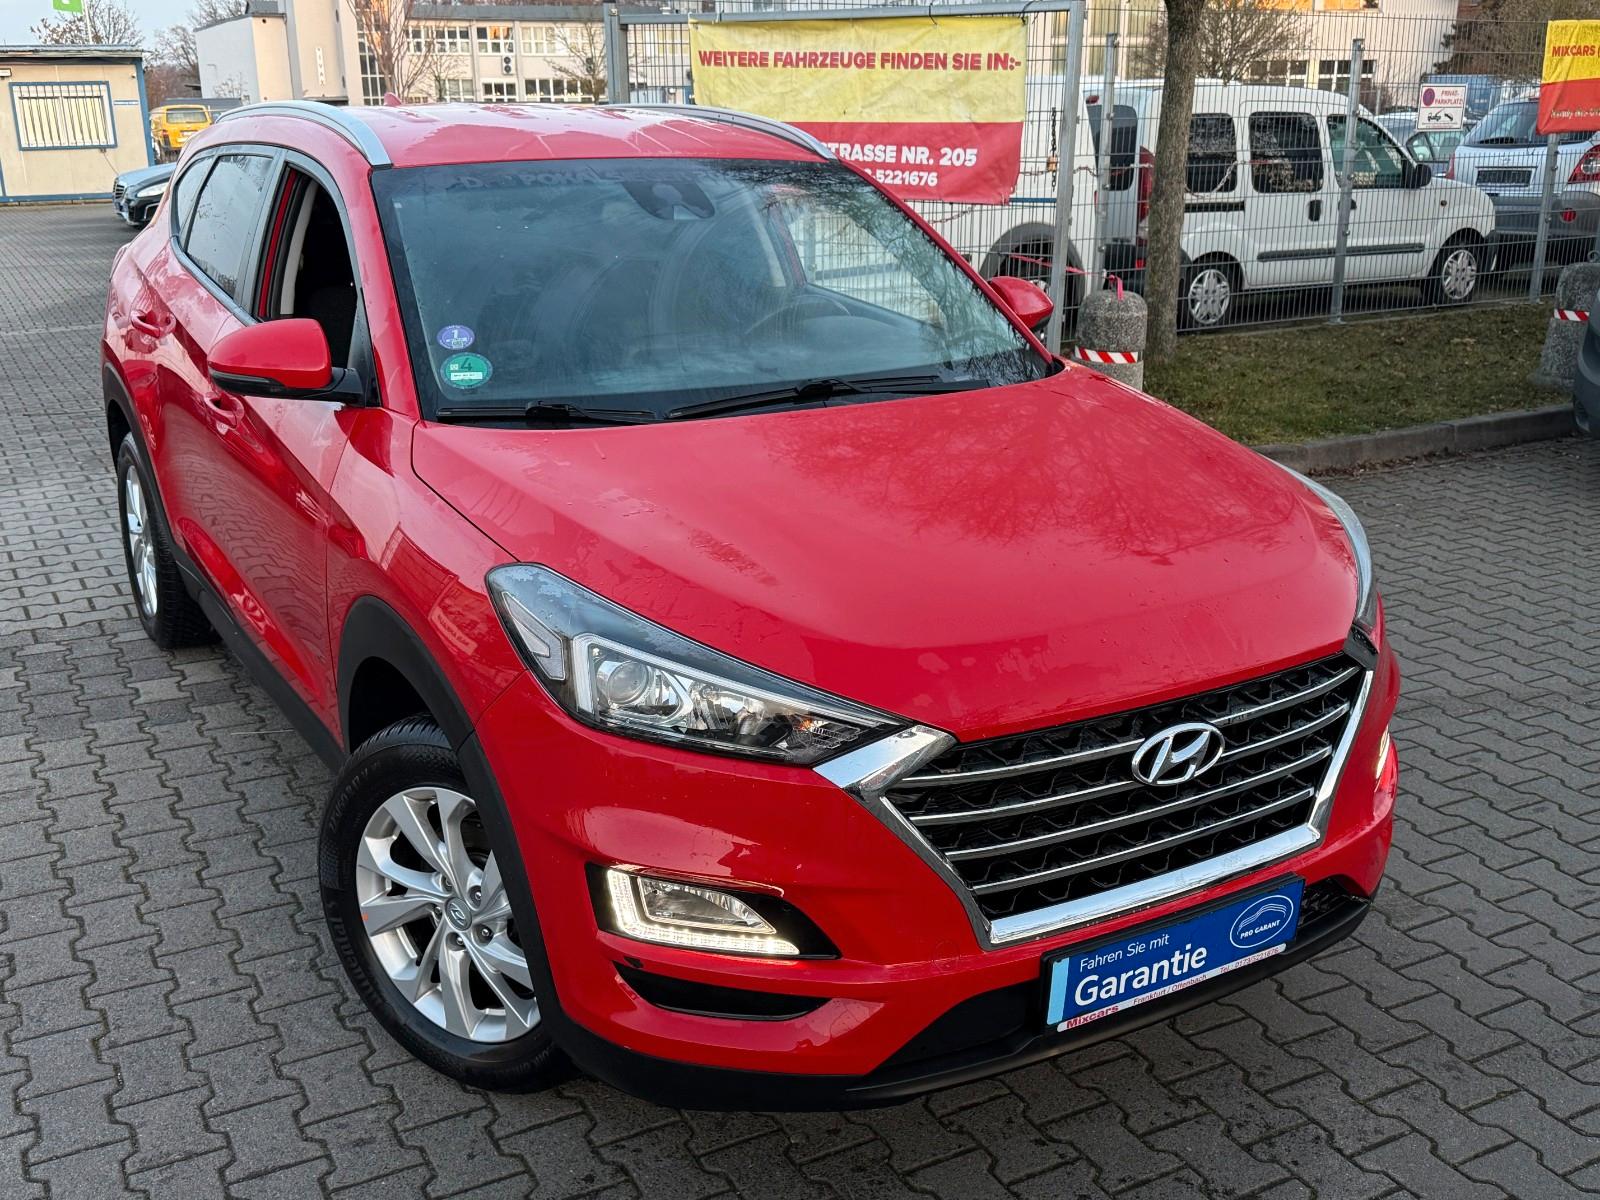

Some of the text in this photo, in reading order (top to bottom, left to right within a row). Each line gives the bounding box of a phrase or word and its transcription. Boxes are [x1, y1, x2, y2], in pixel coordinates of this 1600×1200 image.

[698, 50, 769, 67] WEITERE
[773, 51, 876, 69] FAHRZEUGE
[880, 52, 948, 70] FINDEN
[952, 53, 982, 71] SIE
[1552, 45, 1596, 57] MIXCARS
[821, 142, 978, 167] TRASSE NR. 205
[460, 357, 473, 371] 4
[1240, 919, 1281, 940] PRO GARANT
[1080, 934, 1170, 973] Fahren Sie mit
[1074, 943, 1208, 1007] Garantie
[1066, 1005, 1119, 1029] Mixcars
[1133, 989, 1166, 1005] Frankfurt
[1171, 974, 1207, 992] Offenbach
